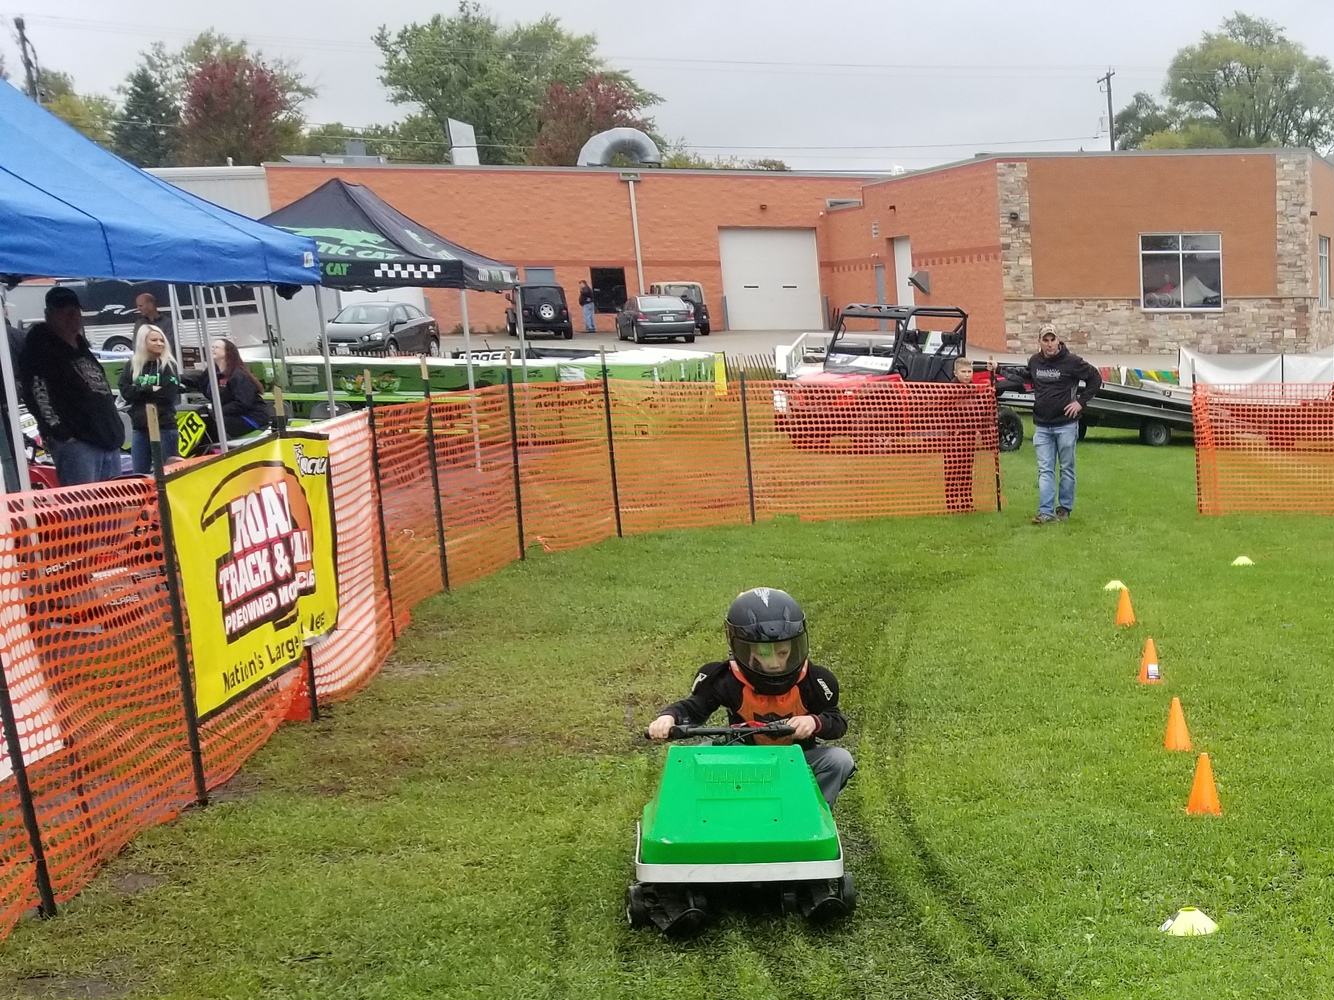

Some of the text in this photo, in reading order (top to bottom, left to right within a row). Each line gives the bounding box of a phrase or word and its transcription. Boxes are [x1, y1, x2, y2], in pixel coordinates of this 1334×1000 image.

[356, 250, 401, 260] CAT
[326, 263, 348, 276] CAT
[219, 547, 273, 605] TRACK
[274, 542, 291, 578] &
[222, 652, 264, 694] Nation's
